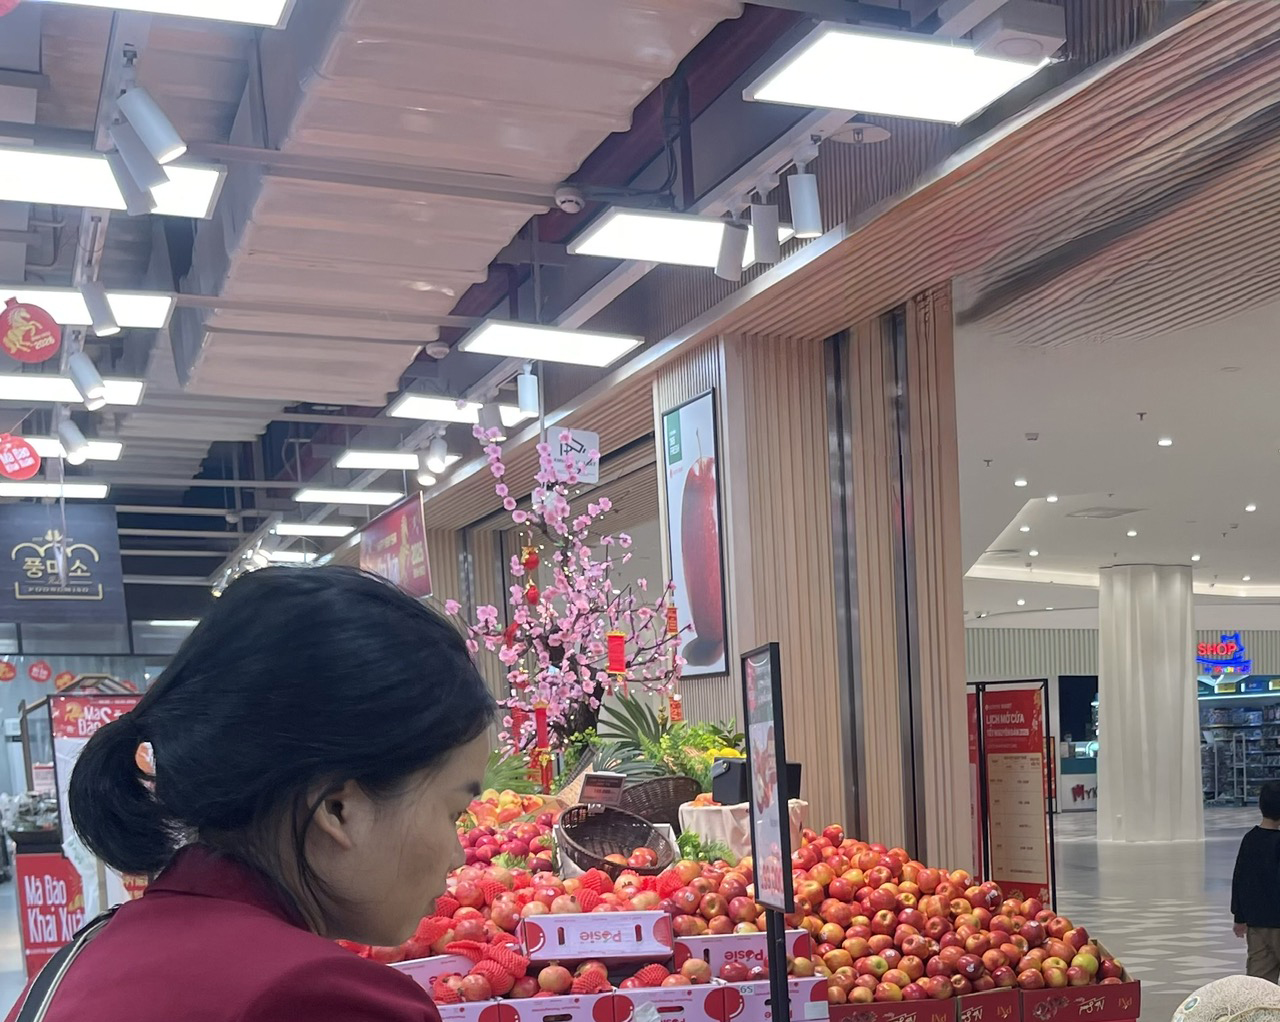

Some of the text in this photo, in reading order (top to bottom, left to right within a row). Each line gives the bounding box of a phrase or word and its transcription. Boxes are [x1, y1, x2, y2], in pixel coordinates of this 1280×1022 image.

[1197, 642, 1238, 656] SHOP
[27, 907, 84, 943] Khai Xuâ
